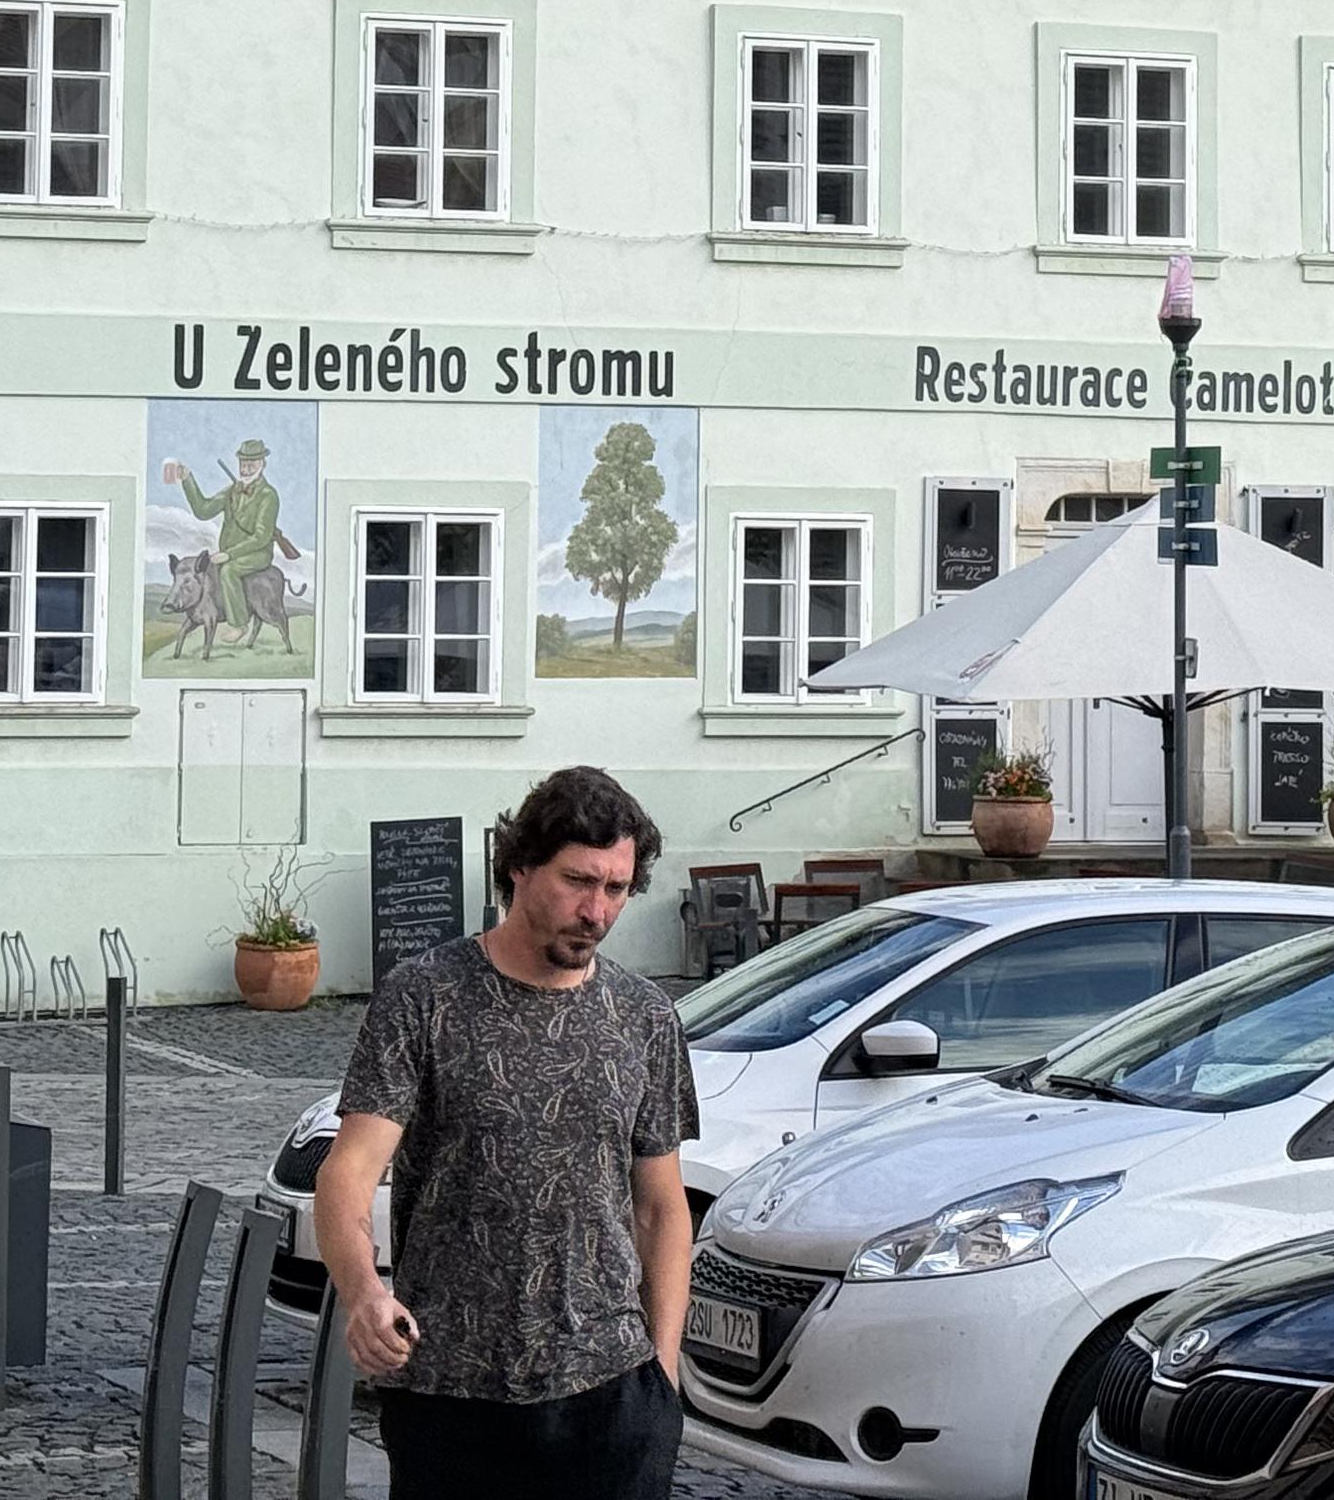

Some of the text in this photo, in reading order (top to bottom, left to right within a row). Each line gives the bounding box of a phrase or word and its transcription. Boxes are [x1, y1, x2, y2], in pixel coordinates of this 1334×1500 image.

[173, 323, 675, 398] U Zeleného stromu
[914, 345, 1148, 409] Restaurace
[689, 1300, 754, 1350] 2SU 1723
